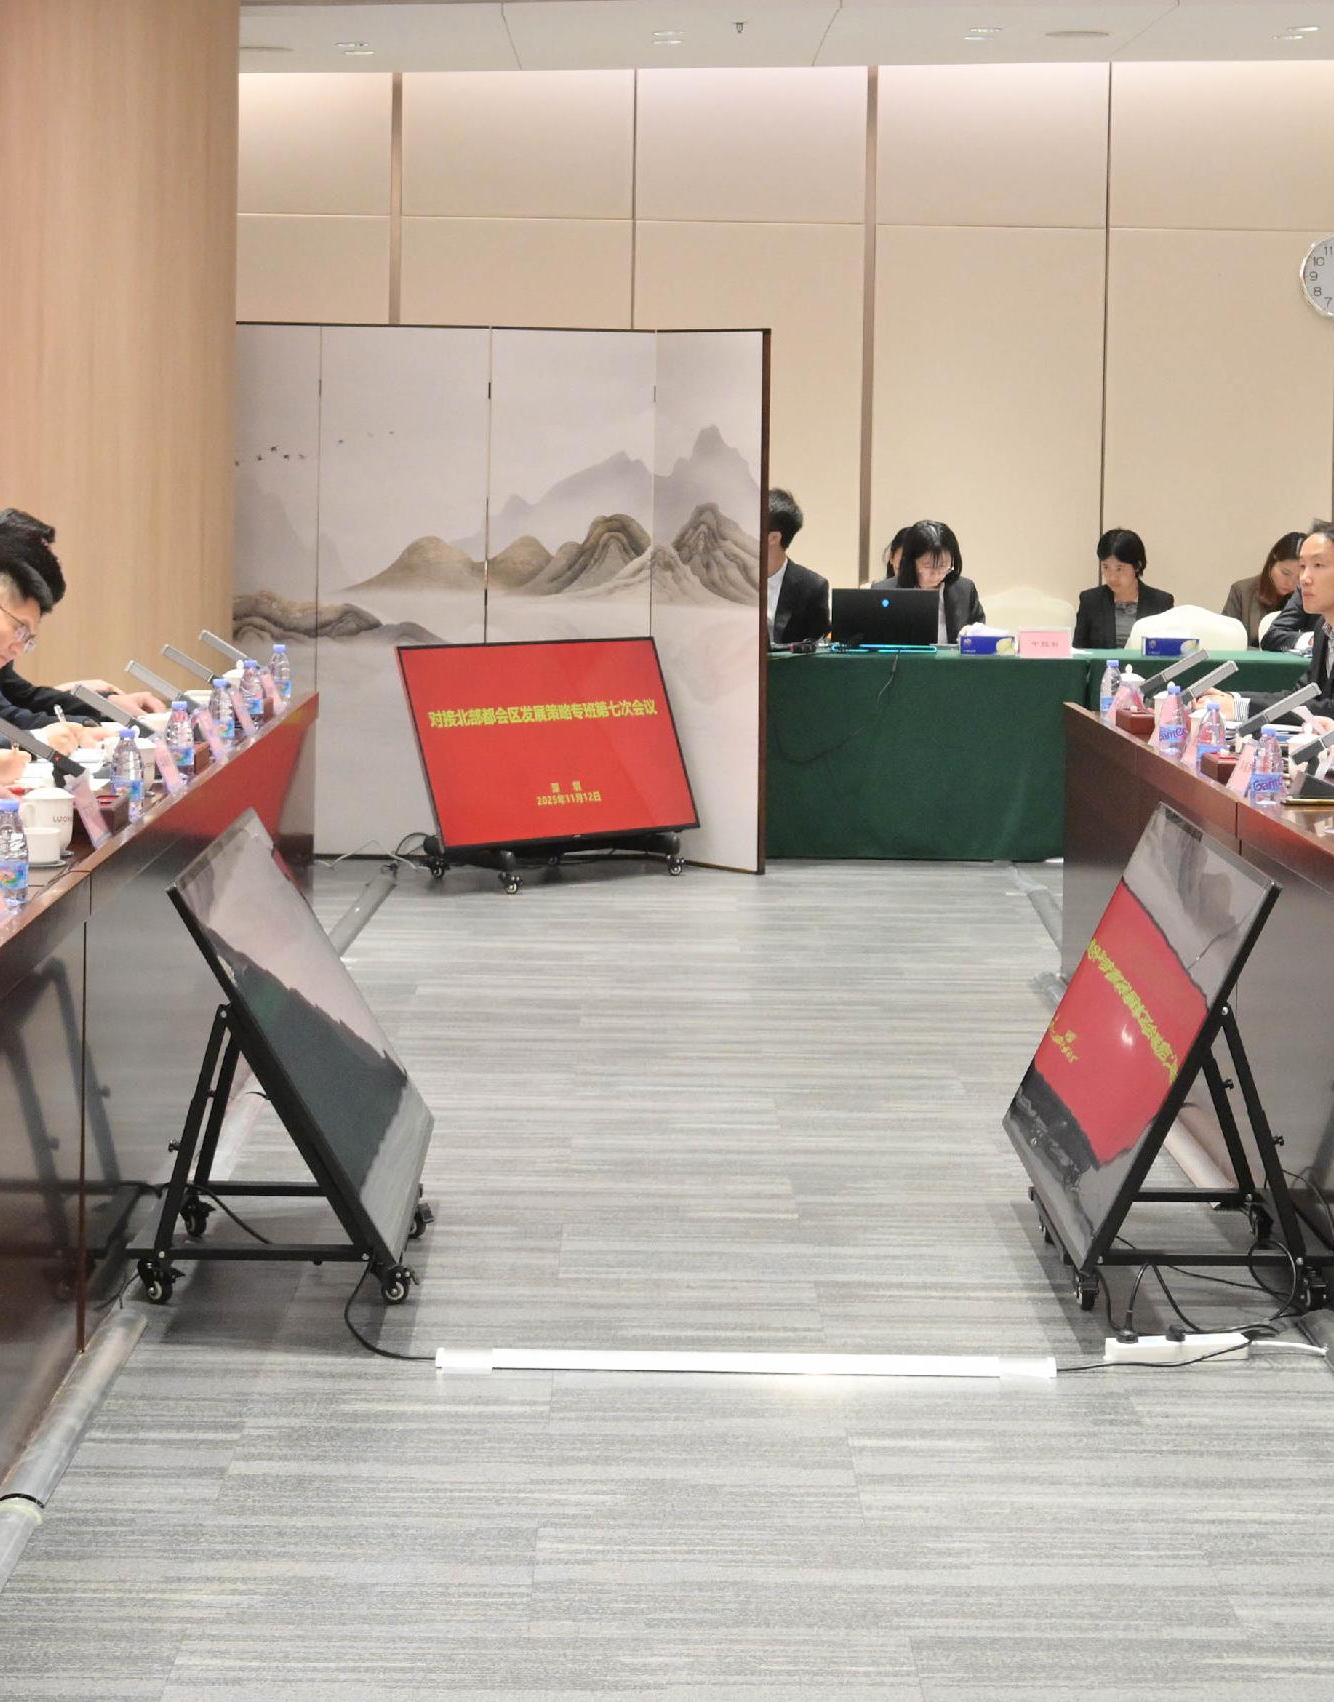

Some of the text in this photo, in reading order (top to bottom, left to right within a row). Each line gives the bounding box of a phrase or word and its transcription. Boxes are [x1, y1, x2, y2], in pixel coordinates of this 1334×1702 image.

[1324, 246, 1333, 256] 11
[1313, 256, 1325, 267] 10
[1309, 271, 1318, 281] 9
[1313, 286, 1322, 297] 8
[1324, 296, 1333, 308] 7
